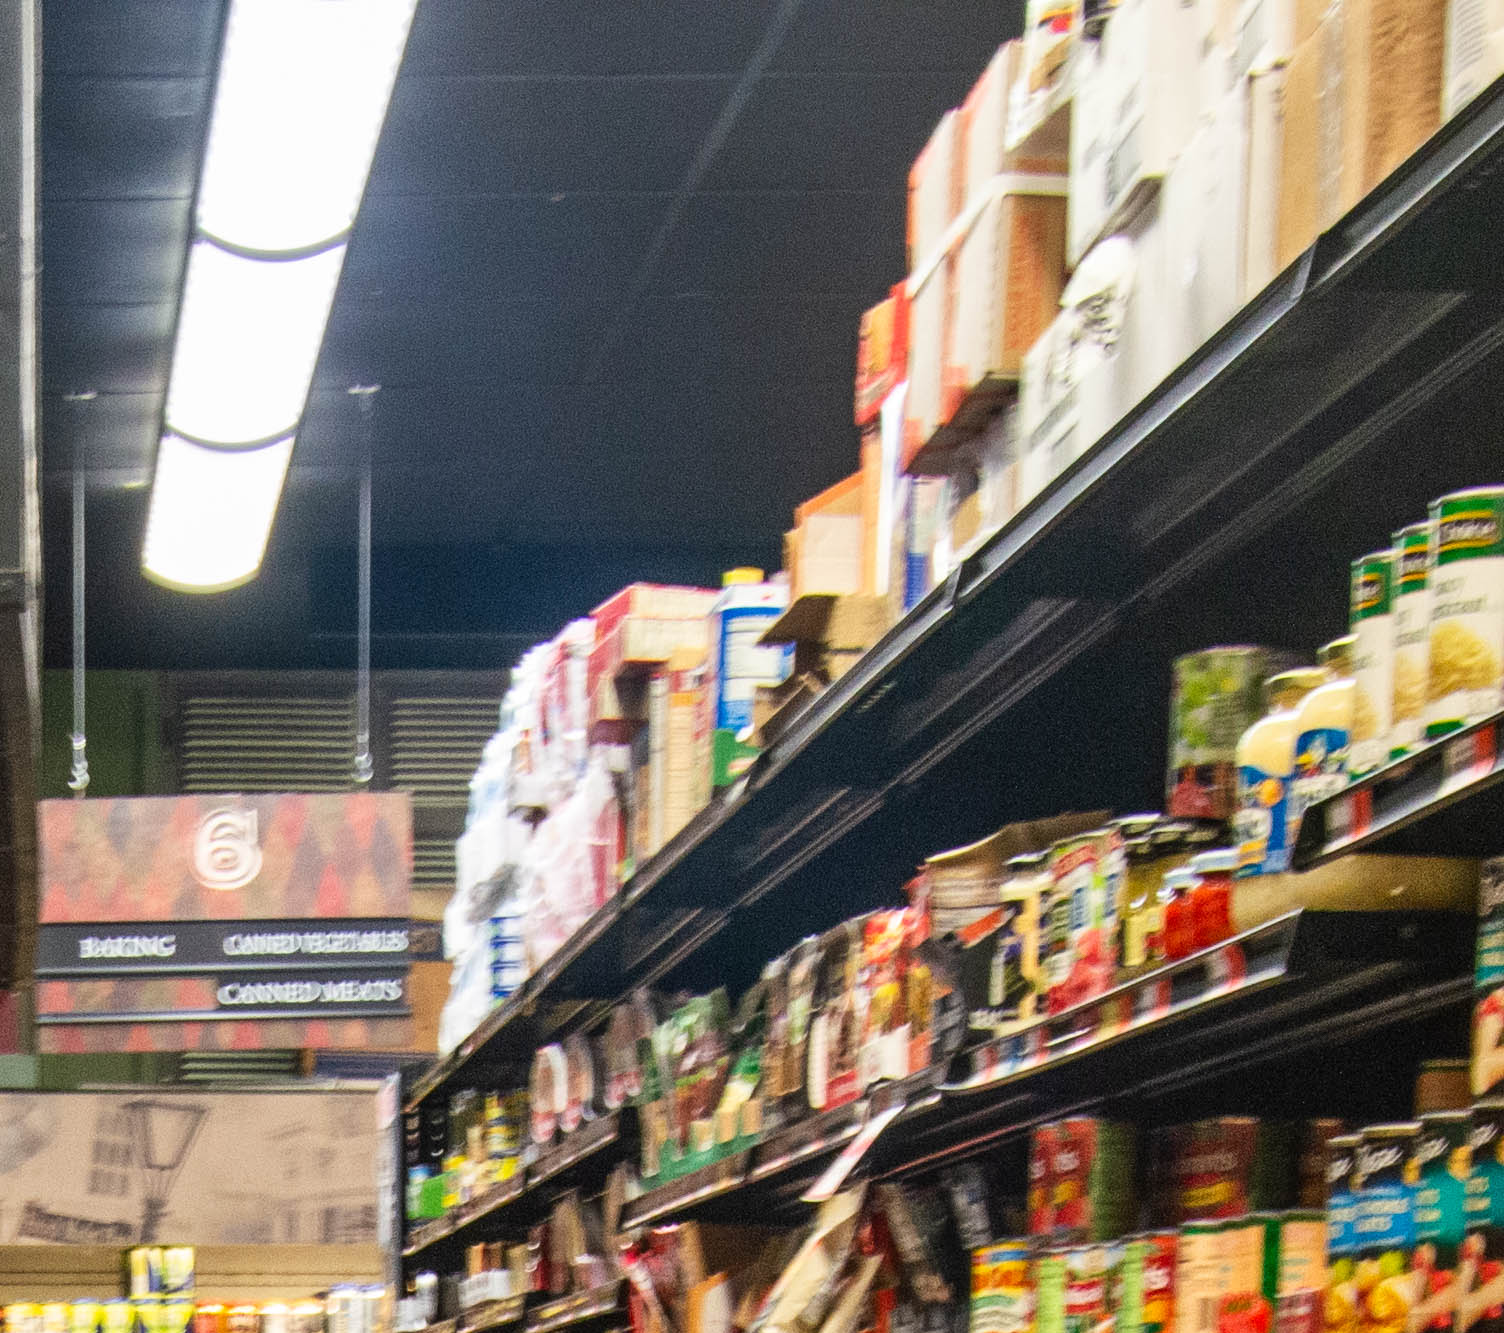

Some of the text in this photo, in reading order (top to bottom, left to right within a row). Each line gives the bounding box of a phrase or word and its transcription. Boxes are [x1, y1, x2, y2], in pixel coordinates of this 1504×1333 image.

[193, 806, 262, 890] 6
[79, 935, 176, 958] BAKING
[223, 930, 409, 955] CANNED VEGETABLES
[217, 980, 403, 1004] CANNED MEATS
